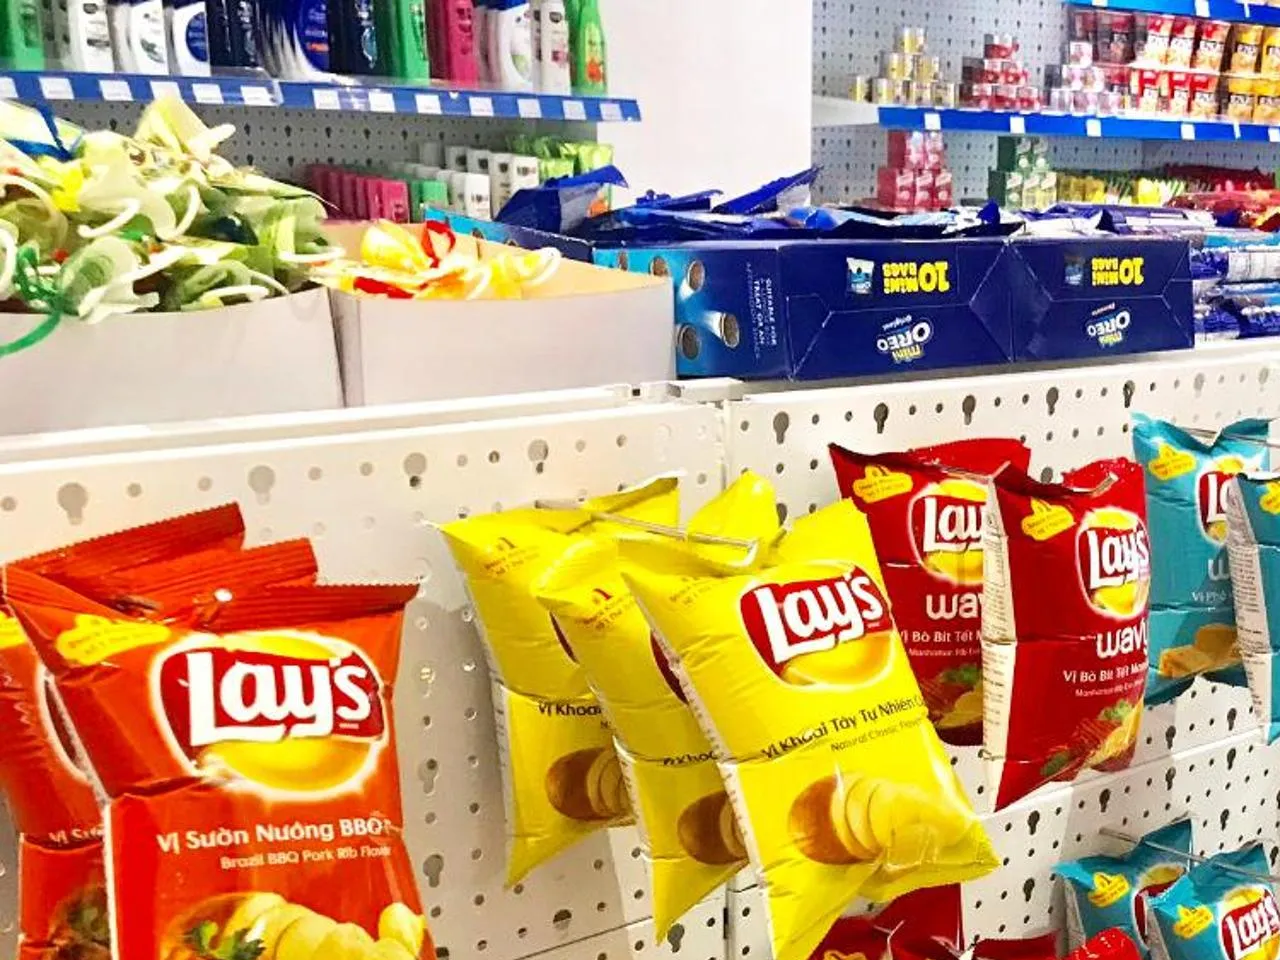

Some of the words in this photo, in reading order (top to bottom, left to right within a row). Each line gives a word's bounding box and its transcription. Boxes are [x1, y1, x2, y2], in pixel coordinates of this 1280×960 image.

[918, 261, 950, 292] 10
[1119, 257, 1144, 285] 10
[877, 322, 931, 354] OREO
[1087, 311, 1130, 336] OREO
[1087, 520, 1148, 589] Lay's
[756, 567, 885, 664] Lay's
[186, 650, 372, 746] Lay's
